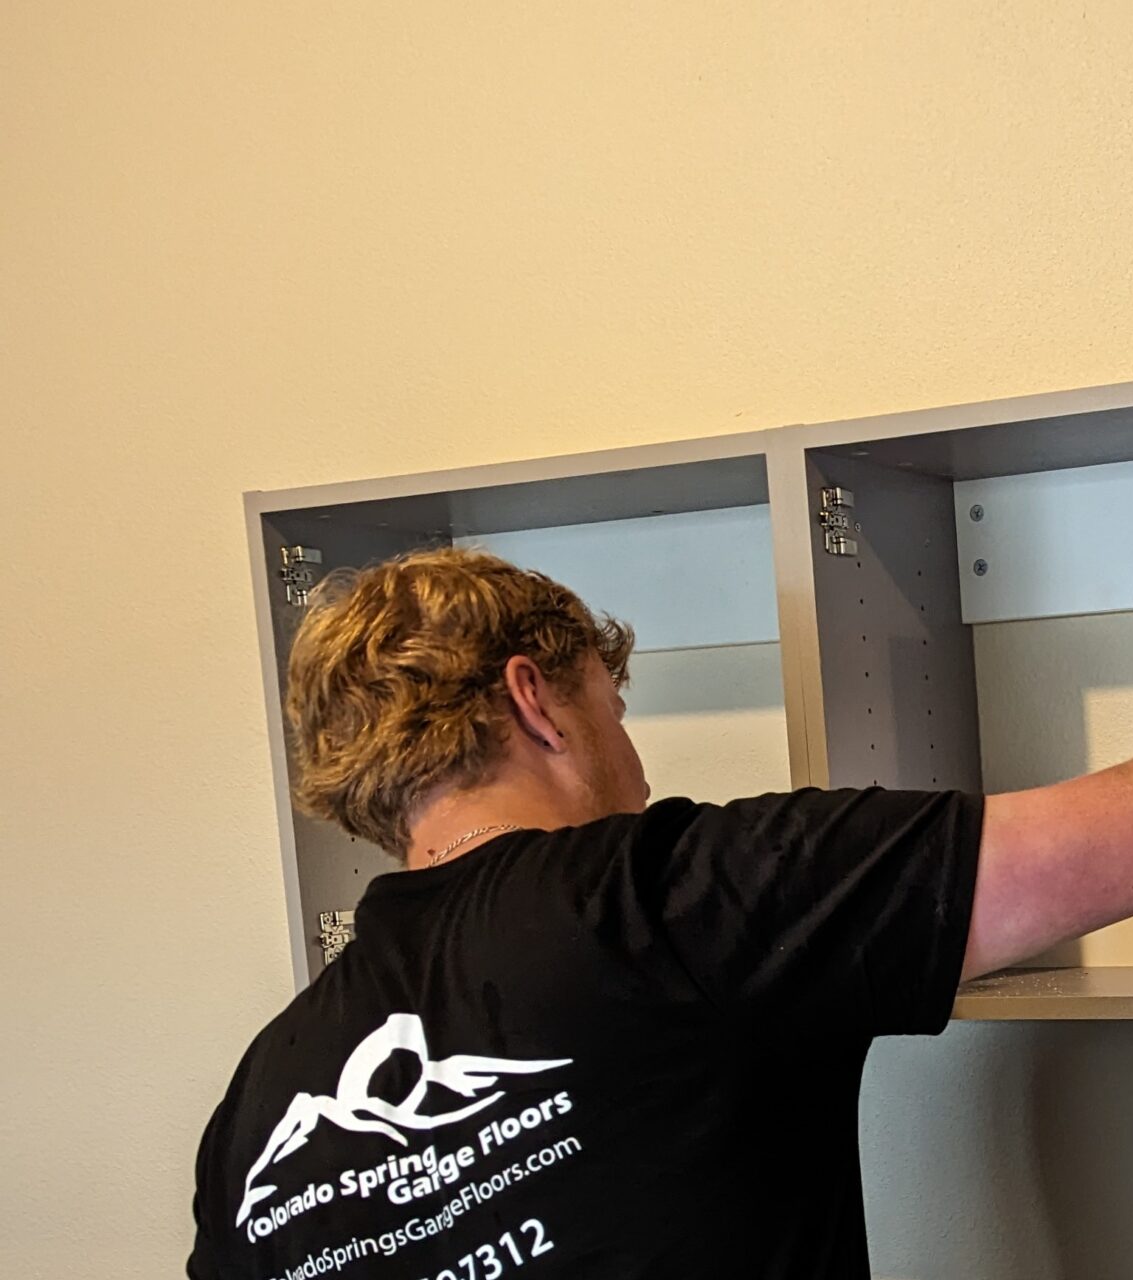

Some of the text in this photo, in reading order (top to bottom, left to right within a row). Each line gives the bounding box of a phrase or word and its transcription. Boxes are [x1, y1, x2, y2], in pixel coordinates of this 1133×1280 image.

[247, 1145, 437, 1243] Colorado Spring
[387, 1091, 573, 1205] Garge Floors
